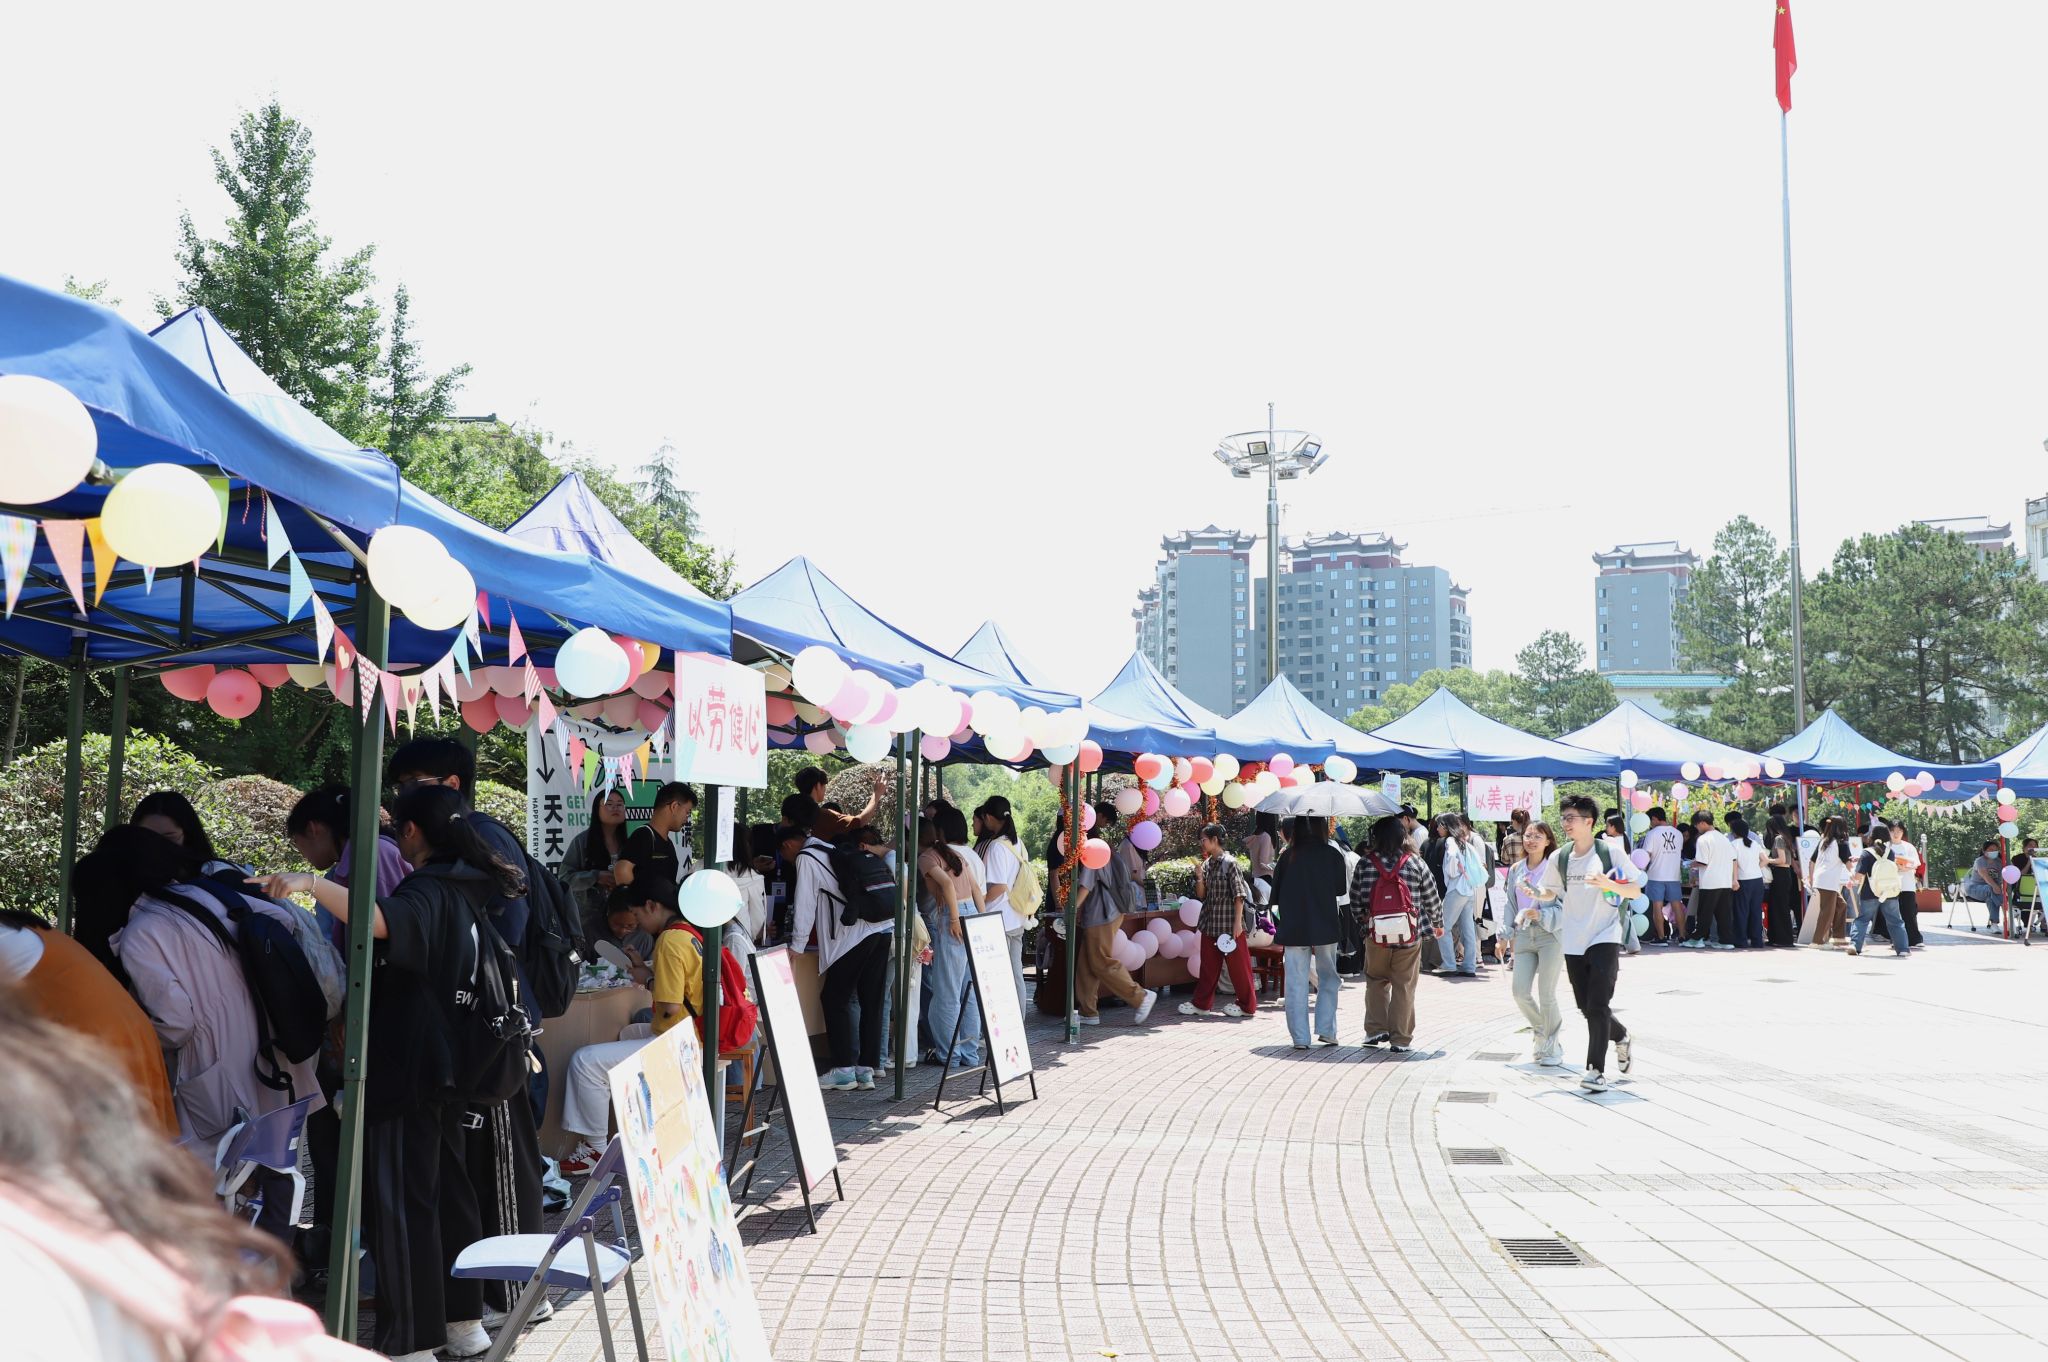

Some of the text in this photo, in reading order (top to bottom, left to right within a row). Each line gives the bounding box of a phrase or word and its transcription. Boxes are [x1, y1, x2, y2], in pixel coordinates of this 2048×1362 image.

[688, 683, 761, 756] 以劳健心
[566, 795, 586, 809] GET
[1475, 784, 1534, 813] 以美育心
